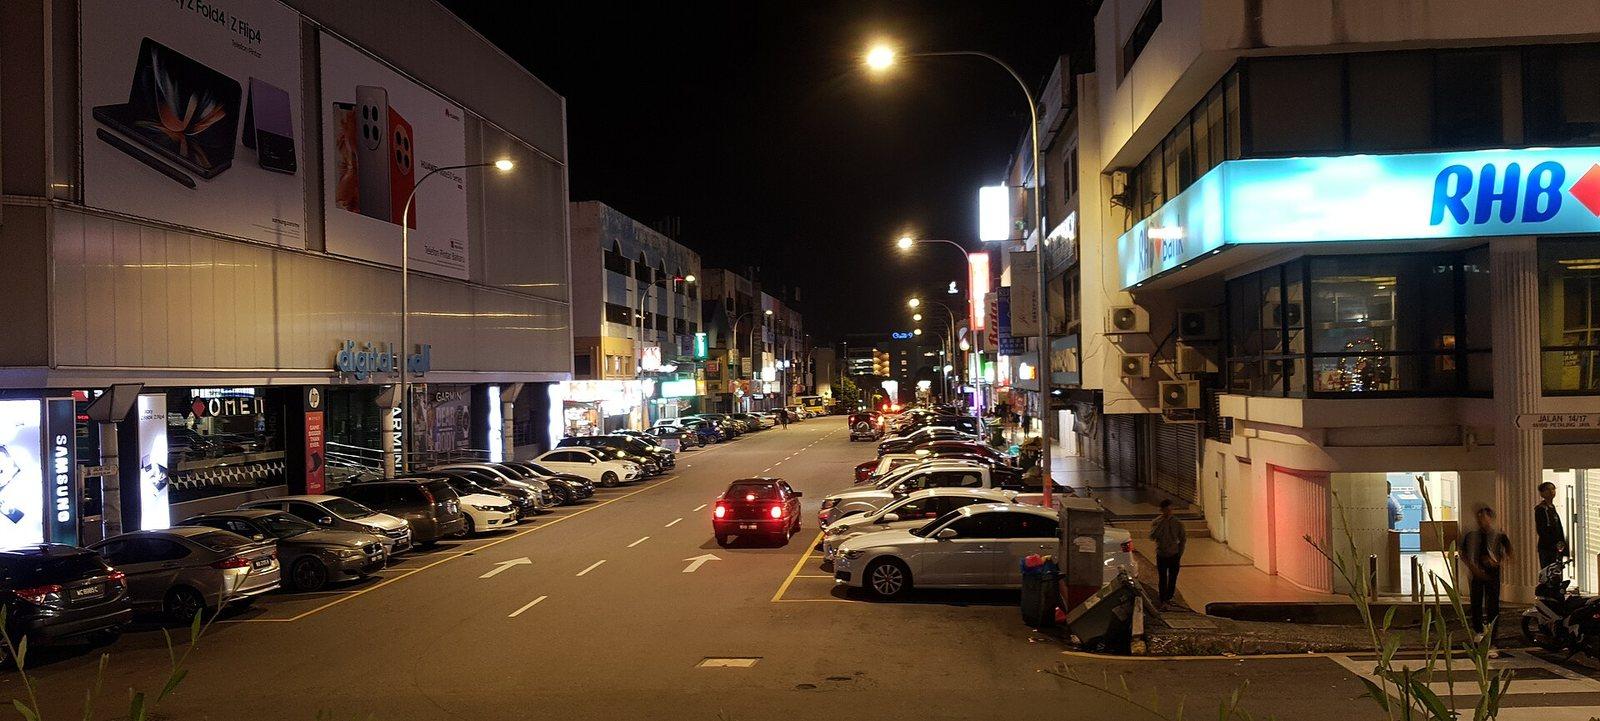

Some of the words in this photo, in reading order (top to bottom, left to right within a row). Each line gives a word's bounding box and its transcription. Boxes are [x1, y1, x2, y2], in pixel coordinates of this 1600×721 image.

[231, 16, 238, 32] Z
[239, 20, 261, 44] Flip4
[1430, 161, 1566, 226] RHB
[337, 340, 394, 380] digital
[209, 397, 264, 417] OMEN
[436, 391, 462, 402] GARMIN
[55, 434, 70, 522] SAMSUNG
